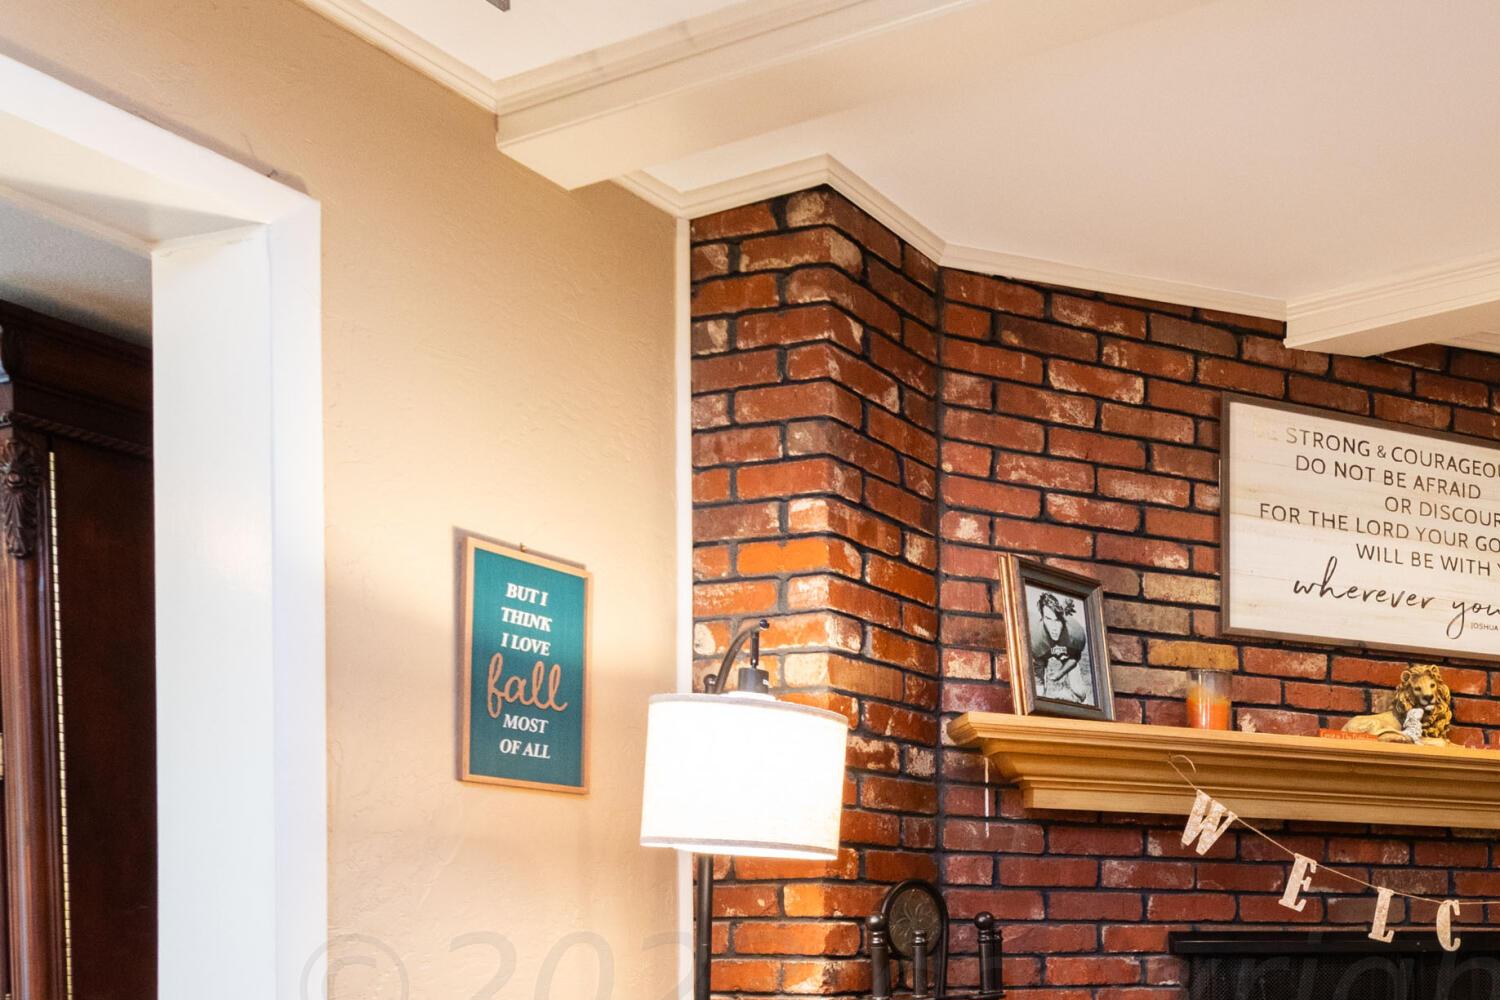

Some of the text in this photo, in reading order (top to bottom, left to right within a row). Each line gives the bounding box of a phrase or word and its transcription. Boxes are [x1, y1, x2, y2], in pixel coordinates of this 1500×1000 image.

[1286, 428, 1370, 457] STRONG
[1376, 445, 1387, 458] &
[1296, 455, 1481, 499] DO NOT BE AFRAID
[1384, 497, 1411, 515] OR
[1260, 503, 1300, 525] FOR
[1309, 510, 1348, 531] THE
[1356, 517, 1409, 540] LORD
[1415, 527, 1468, 549] YOUR
[1356, 543, 1404, 566] WILL
[1411, 551, 1434, 569] BE
[1440, 555, 1490, 577] WITH
[505, 583, 548, 607] BUT I
[1293, 556, 1435, 609] wherever
[501, 607, 552, 632] THINK
[501, 633, 551, 656] I LOVE
[487, 652, 568, 719] fall
[503, 714, 549, 734] MOST
[499, 738, 551, 759] OF ALL
